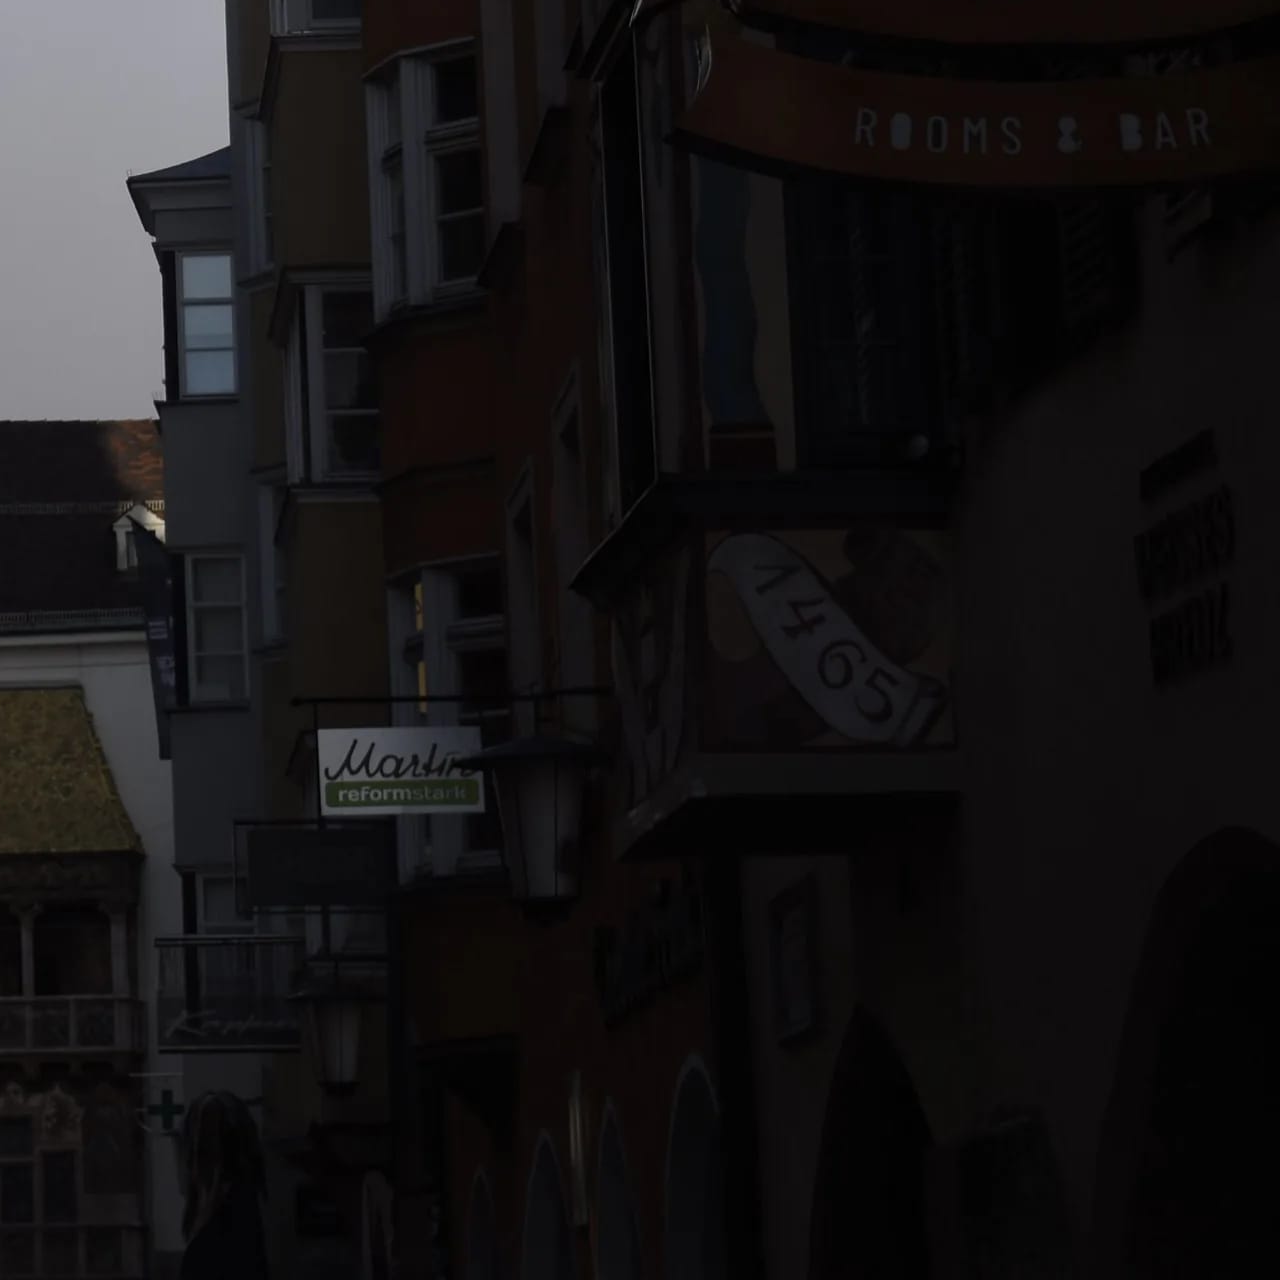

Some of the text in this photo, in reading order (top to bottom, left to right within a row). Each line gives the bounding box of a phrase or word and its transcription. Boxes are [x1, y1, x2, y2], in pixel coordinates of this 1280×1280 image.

[853, 105, 1214, 156] ROOMS & BAR
[754, 562, 901, 725] 1465
[338, 783, 466, 803] reformstark
